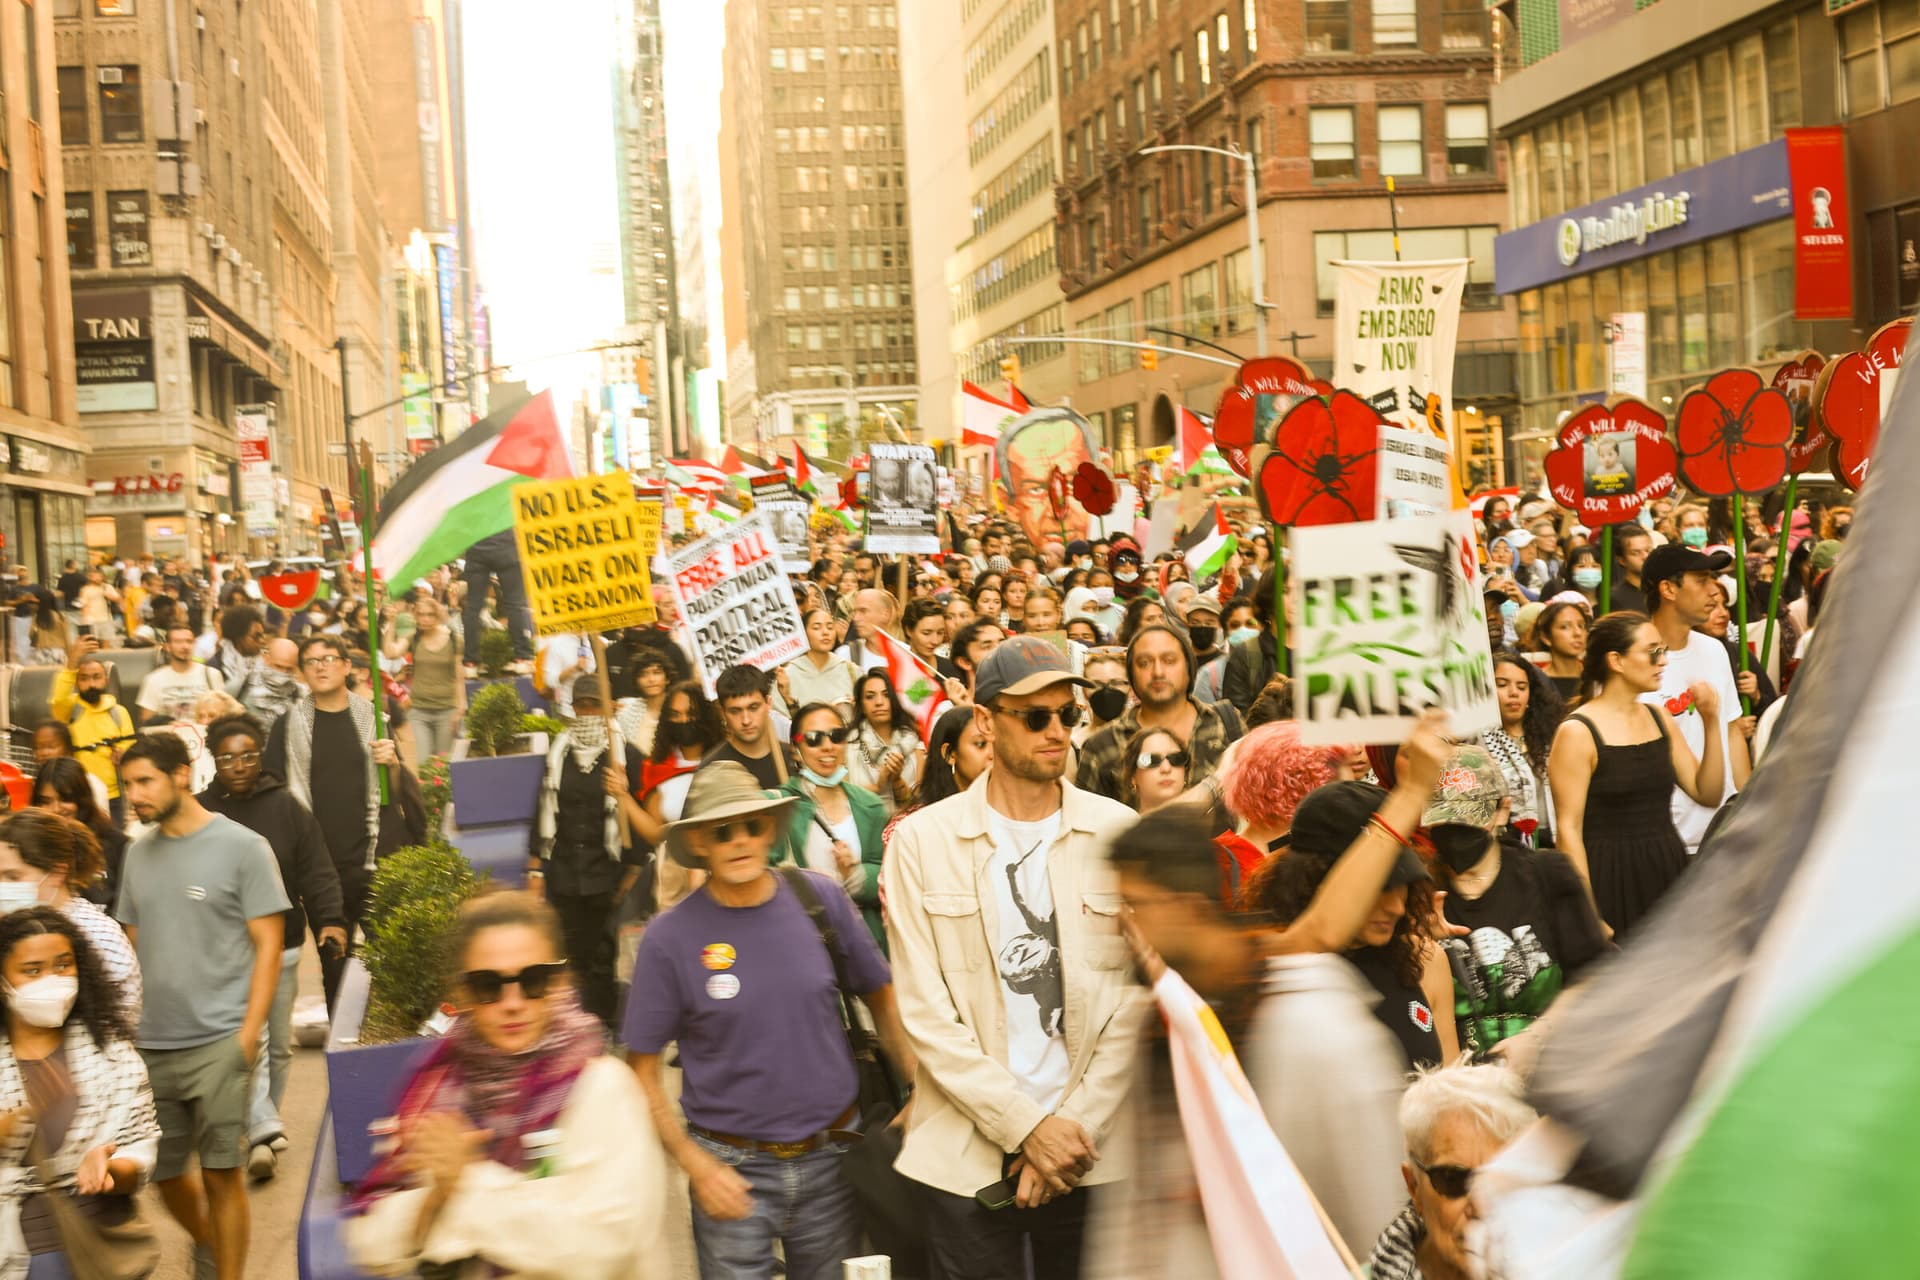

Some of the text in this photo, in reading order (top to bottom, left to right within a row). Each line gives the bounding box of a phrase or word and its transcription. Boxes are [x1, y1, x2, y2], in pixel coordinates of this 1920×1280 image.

[1378, 276, 1424, 305] ARMS
[84, 317, 141, 339] TAN
[1358, 308, 1436, 339] EMBARGO
[77, 356, 110, 367] ETAIL
[1381, 341, 1417, 371] NOW
[1855, 350, 1887, 385] WE
[1237, 382, 1255, 401] WE
[1254, 375, 1283, 392] WILL
[1563, 417, 1664, 449] WE WILL HONOR
[112, 472, 185, 497] KING
[1553, 483, 1576, 504] ALL
[1583, 497, 1609, 512] OUR
[1619, 471, 1675, 511] MARTYRS
[519, 492, 557, 520] NO
[525, 515, 634, 557] ISRAELI
[531, 551, 640, 589] WAR ON
[675, 550, 728, 604] FREE
[731, 531, 774, 573] ALL
[538, 583, 644, 617] LEBANON
[686, 561, 778, 617] PALESTINIAN
[1304, 571, 1418, 627] FREE
[696, 588, 789, 648] POLITICAL
